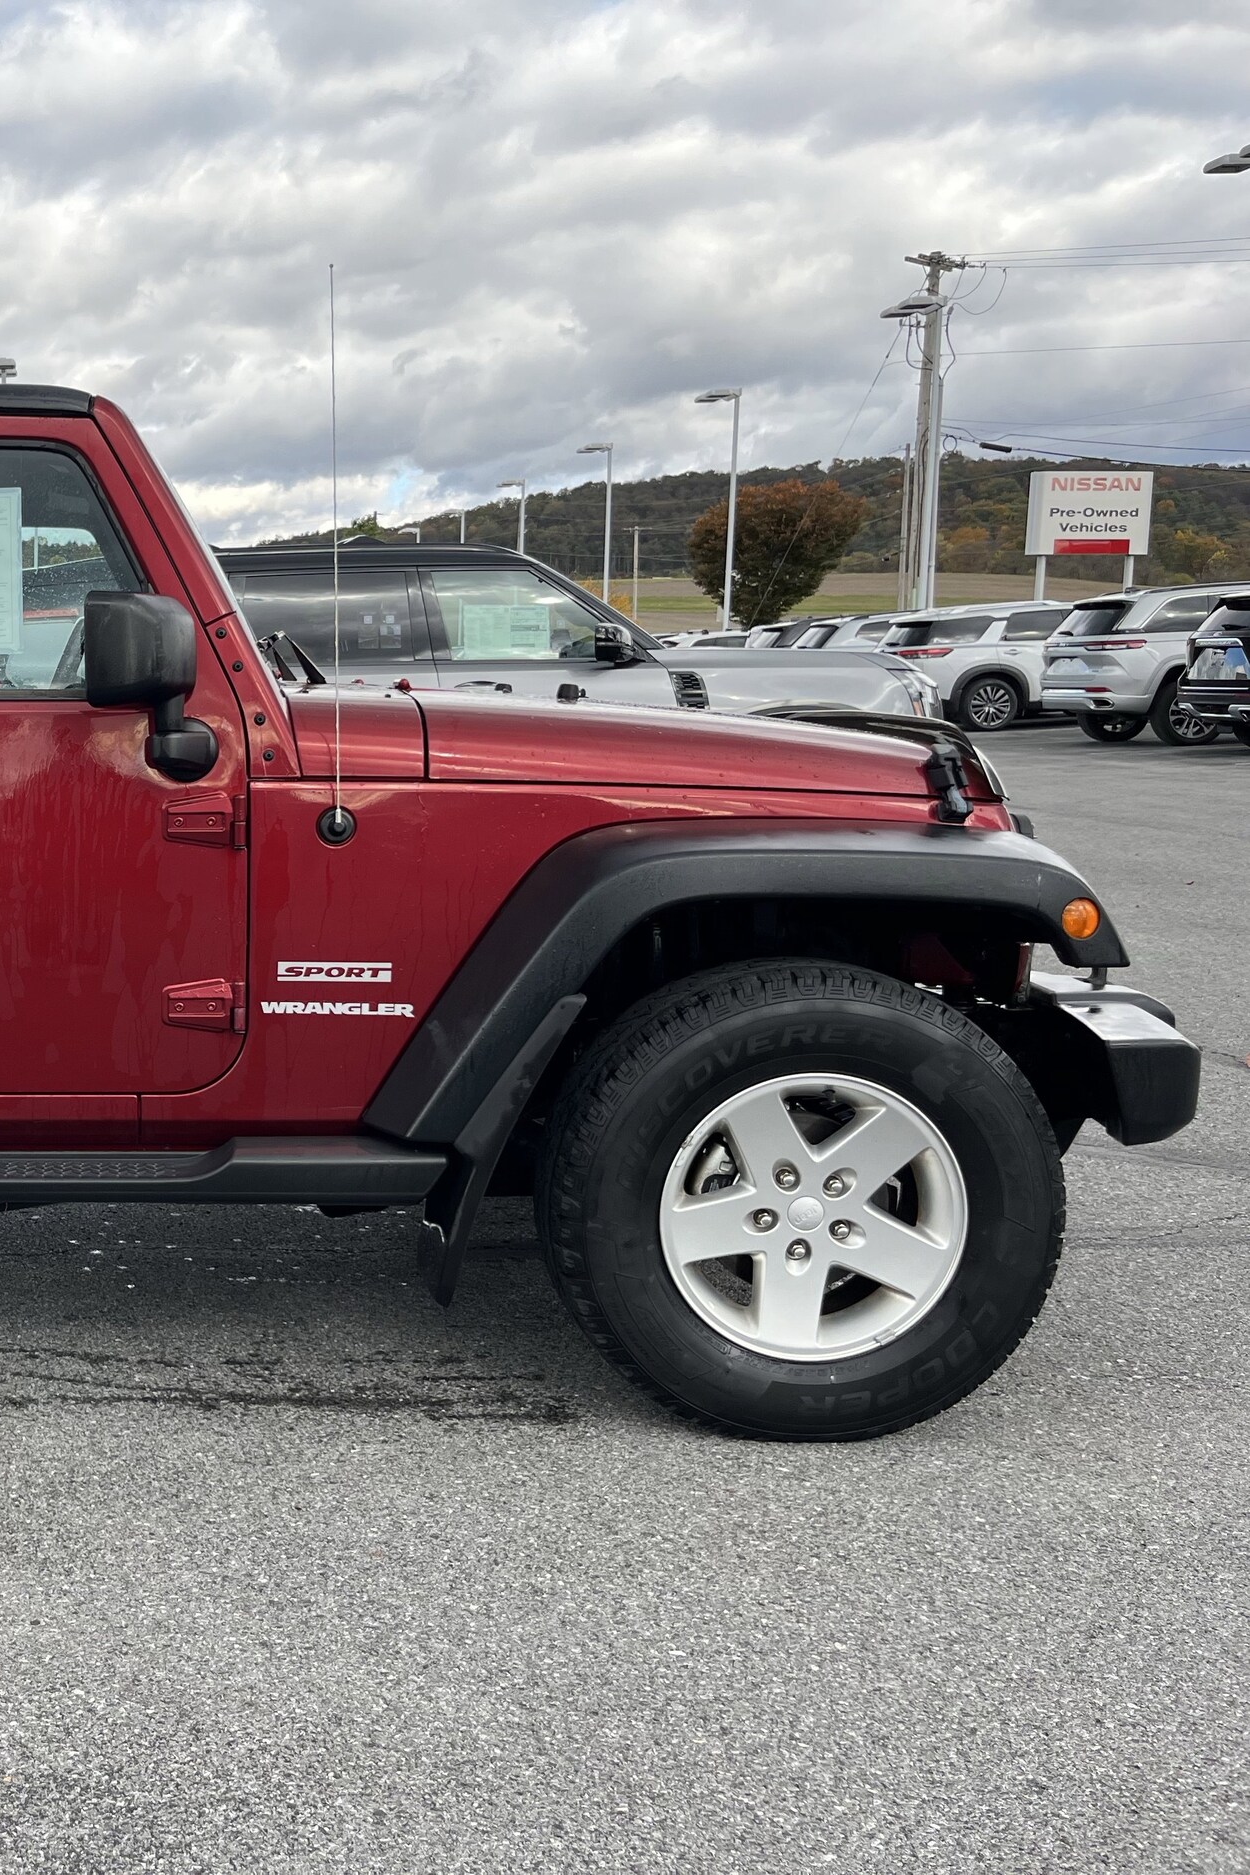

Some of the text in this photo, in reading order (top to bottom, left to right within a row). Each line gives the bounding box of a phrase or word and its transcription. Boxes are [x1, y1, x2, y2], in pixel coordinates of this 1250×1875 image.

[1051, 478, 1141, 491] NISSAN
[1049, 507, 1139, 518] Pre-Owned
[1059, 523, 1128, 533] Vehicles
[280, 965, 390, 979] SPORT
[261, 1001, 415, 1018] WRANGLER
